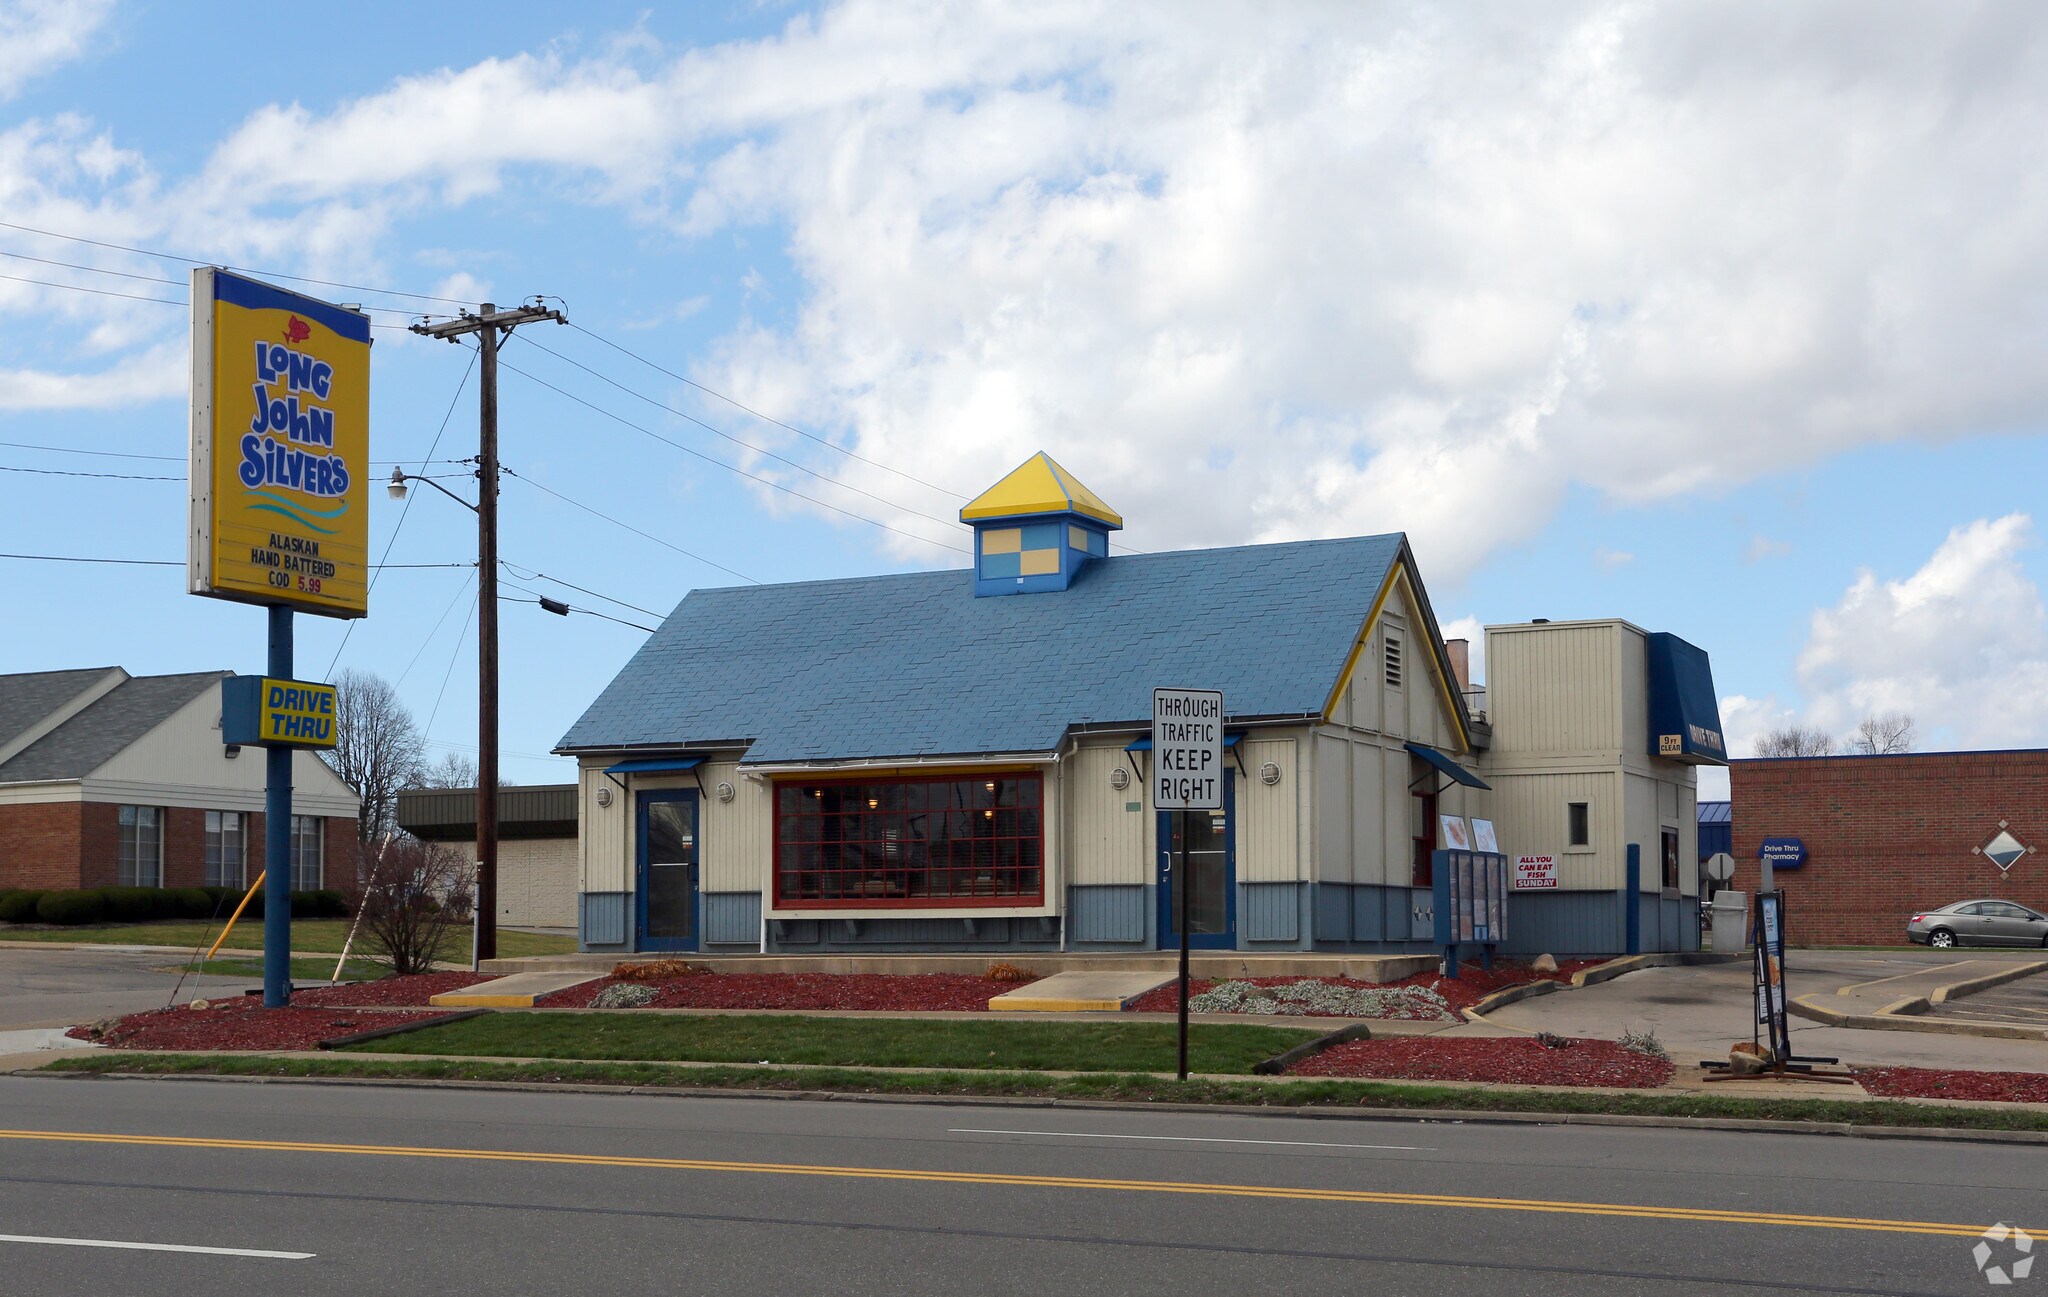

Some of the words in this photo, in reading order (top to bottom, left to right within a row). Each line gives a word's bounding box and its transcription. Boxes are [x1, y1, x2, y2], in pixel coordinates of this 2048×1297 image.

[269, 533, 319, 556] ALASKAN
[251, 548, 280, 567] HAND
[284, 555, 335, 577] BATTERED
[268, 571, 290, 588] COD
[298, 576, 321, 593] 5.99
[268, 686, 333, 714] DRIVE
[1158, 697, 1219, 718] THROUGH
[271, 713, 331, 739] THRU
[1161, 723, 1214, 742] TRAFFIC
[1660, 744, 1681, 752] CLEAR
[1664, 736, 1670, 745] 9
[1162, 748, 1212, 771] KEEP
[1161, 777, 1215, 800] RIGHT
[1763, 853, 1800, 861] Pharmacy
[1518, 879, 1554, 887] SUNDAY
